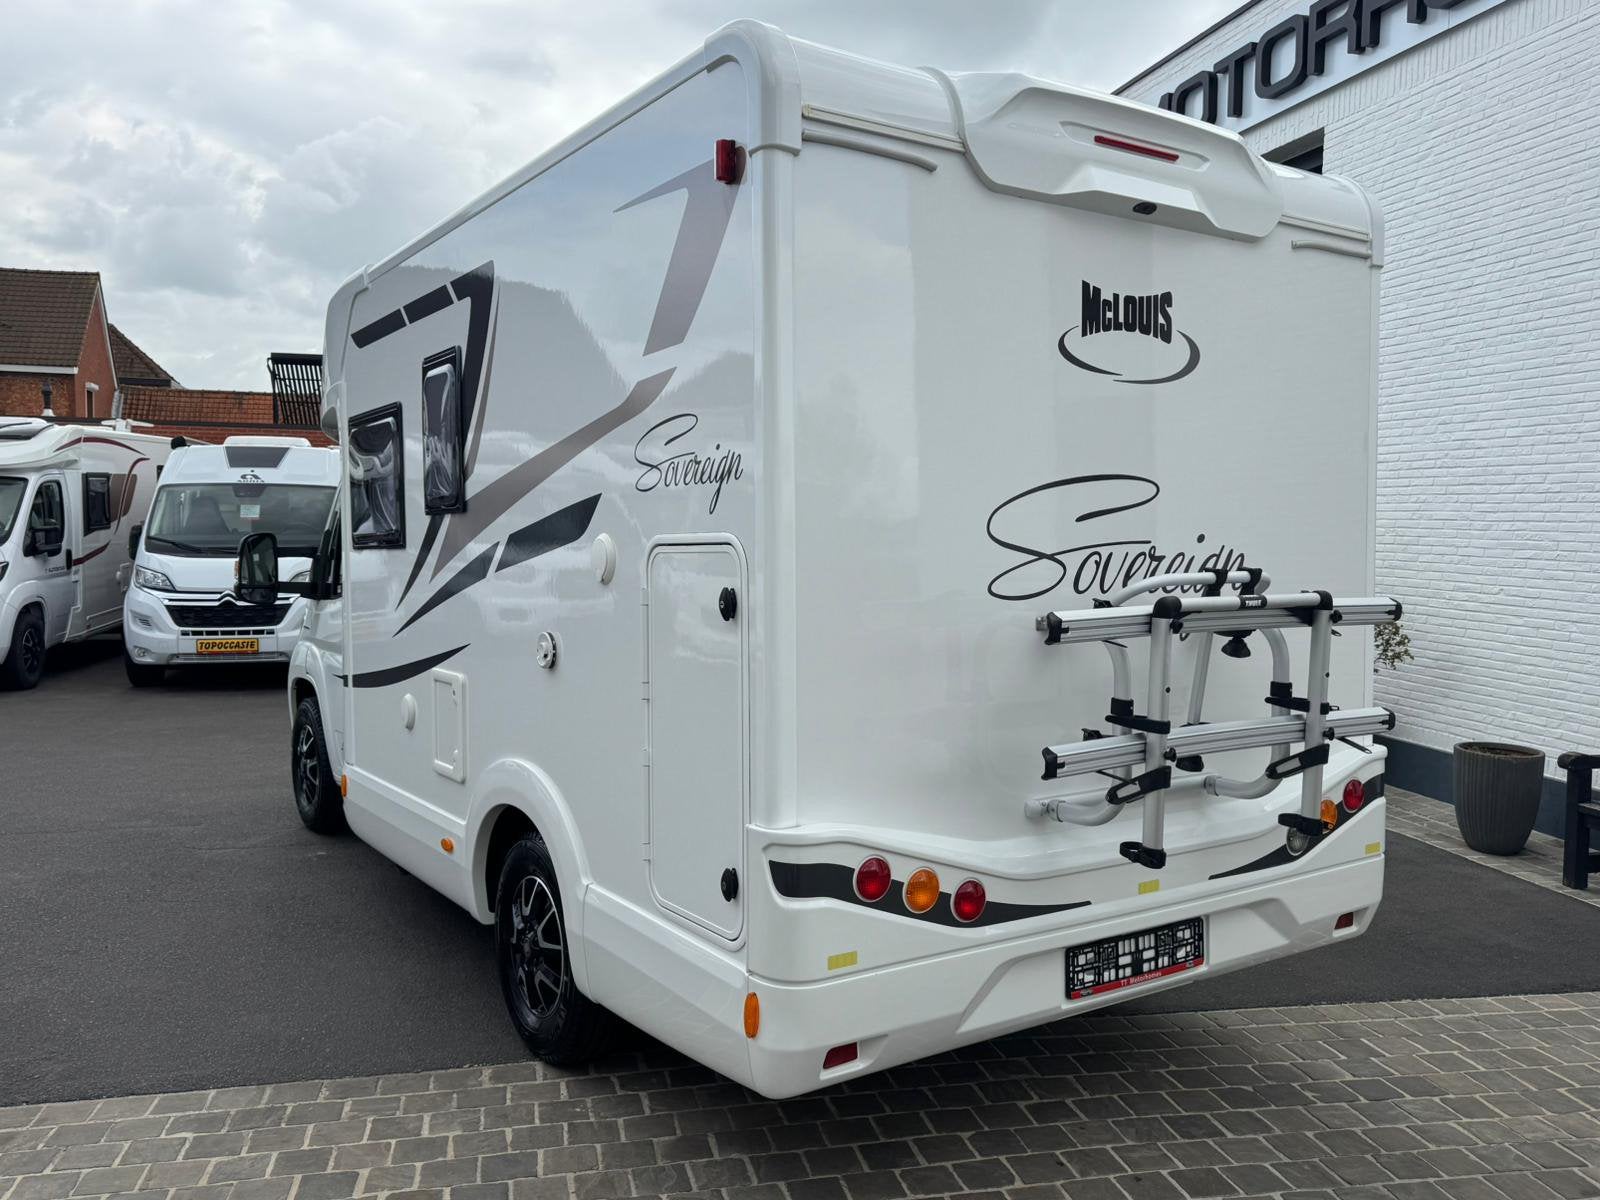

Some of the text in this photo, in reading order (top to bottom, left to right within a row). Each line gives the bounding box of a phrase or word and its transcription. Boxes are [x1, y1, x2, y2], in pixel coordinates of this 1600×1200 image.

[634, 413, 744, 515] Sovereign
[199, 640, 256, 650] TOPOCCASIE
[1130, 971, 1162, 984] Motorhomes
